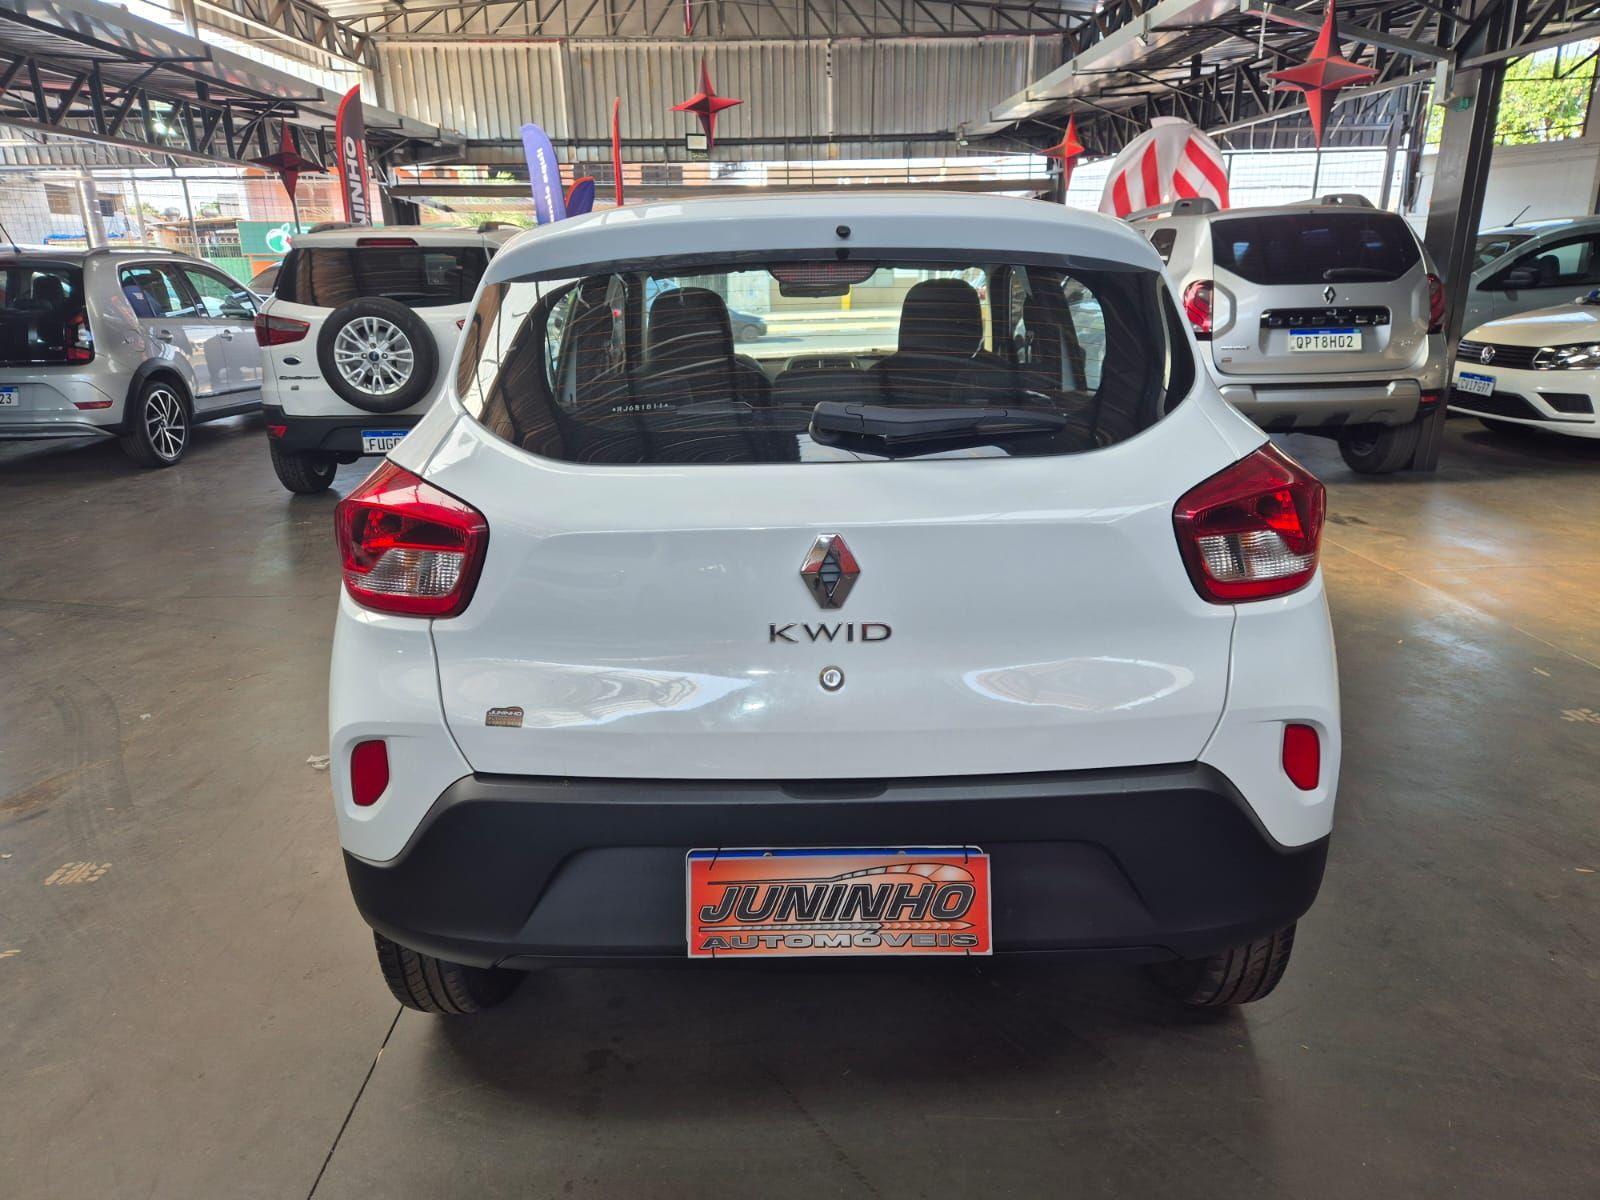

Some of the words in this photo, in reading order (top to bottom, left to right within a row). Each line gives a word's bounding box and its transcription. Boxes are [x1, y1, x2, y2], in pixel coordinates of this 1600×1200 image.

[345, 136, 367, 224] NINHO
[769, 622, 892, 643] KWID
[699, 883, 976, 922] JUNINHO
[700, 930, 979, 949] AUTOMÓVEIS
